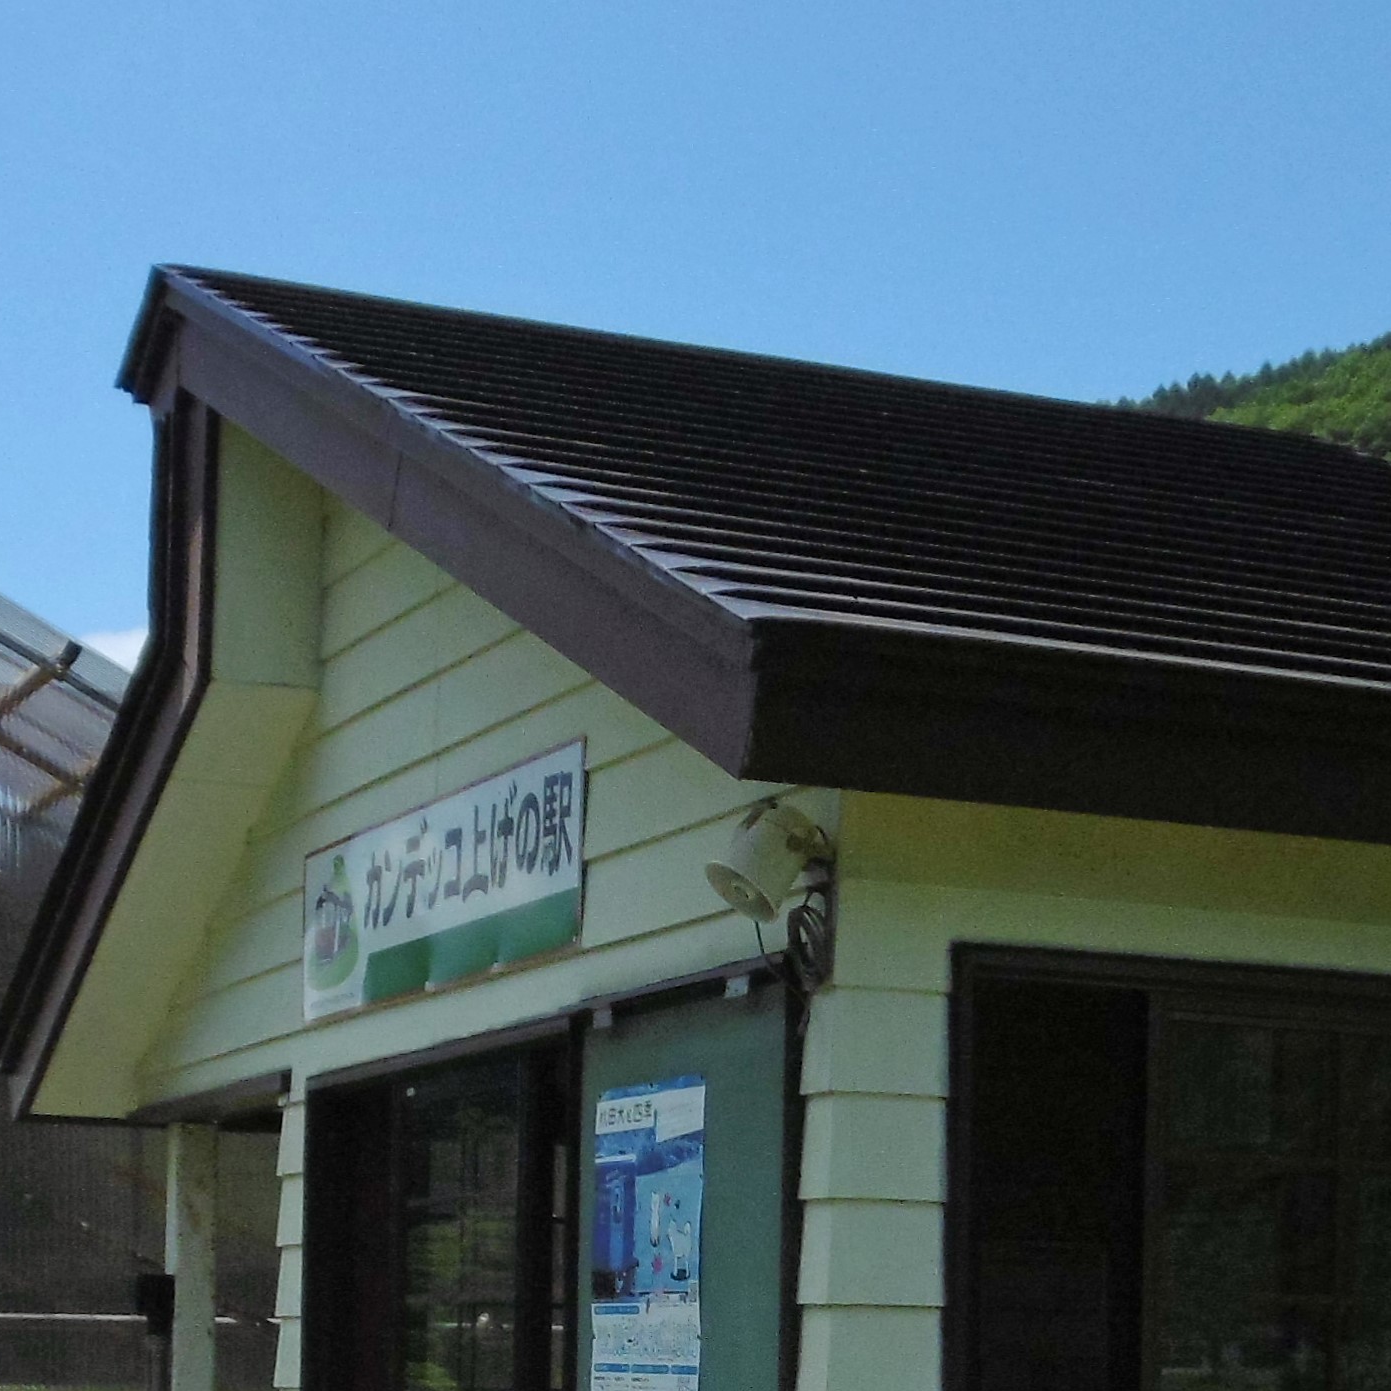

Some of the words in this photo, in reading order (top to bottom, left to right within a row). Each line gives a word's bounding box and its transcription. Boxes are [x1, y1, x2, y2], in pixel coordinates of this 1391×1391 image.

[363, 772, 573, 928] カンデッコ上げの駅
